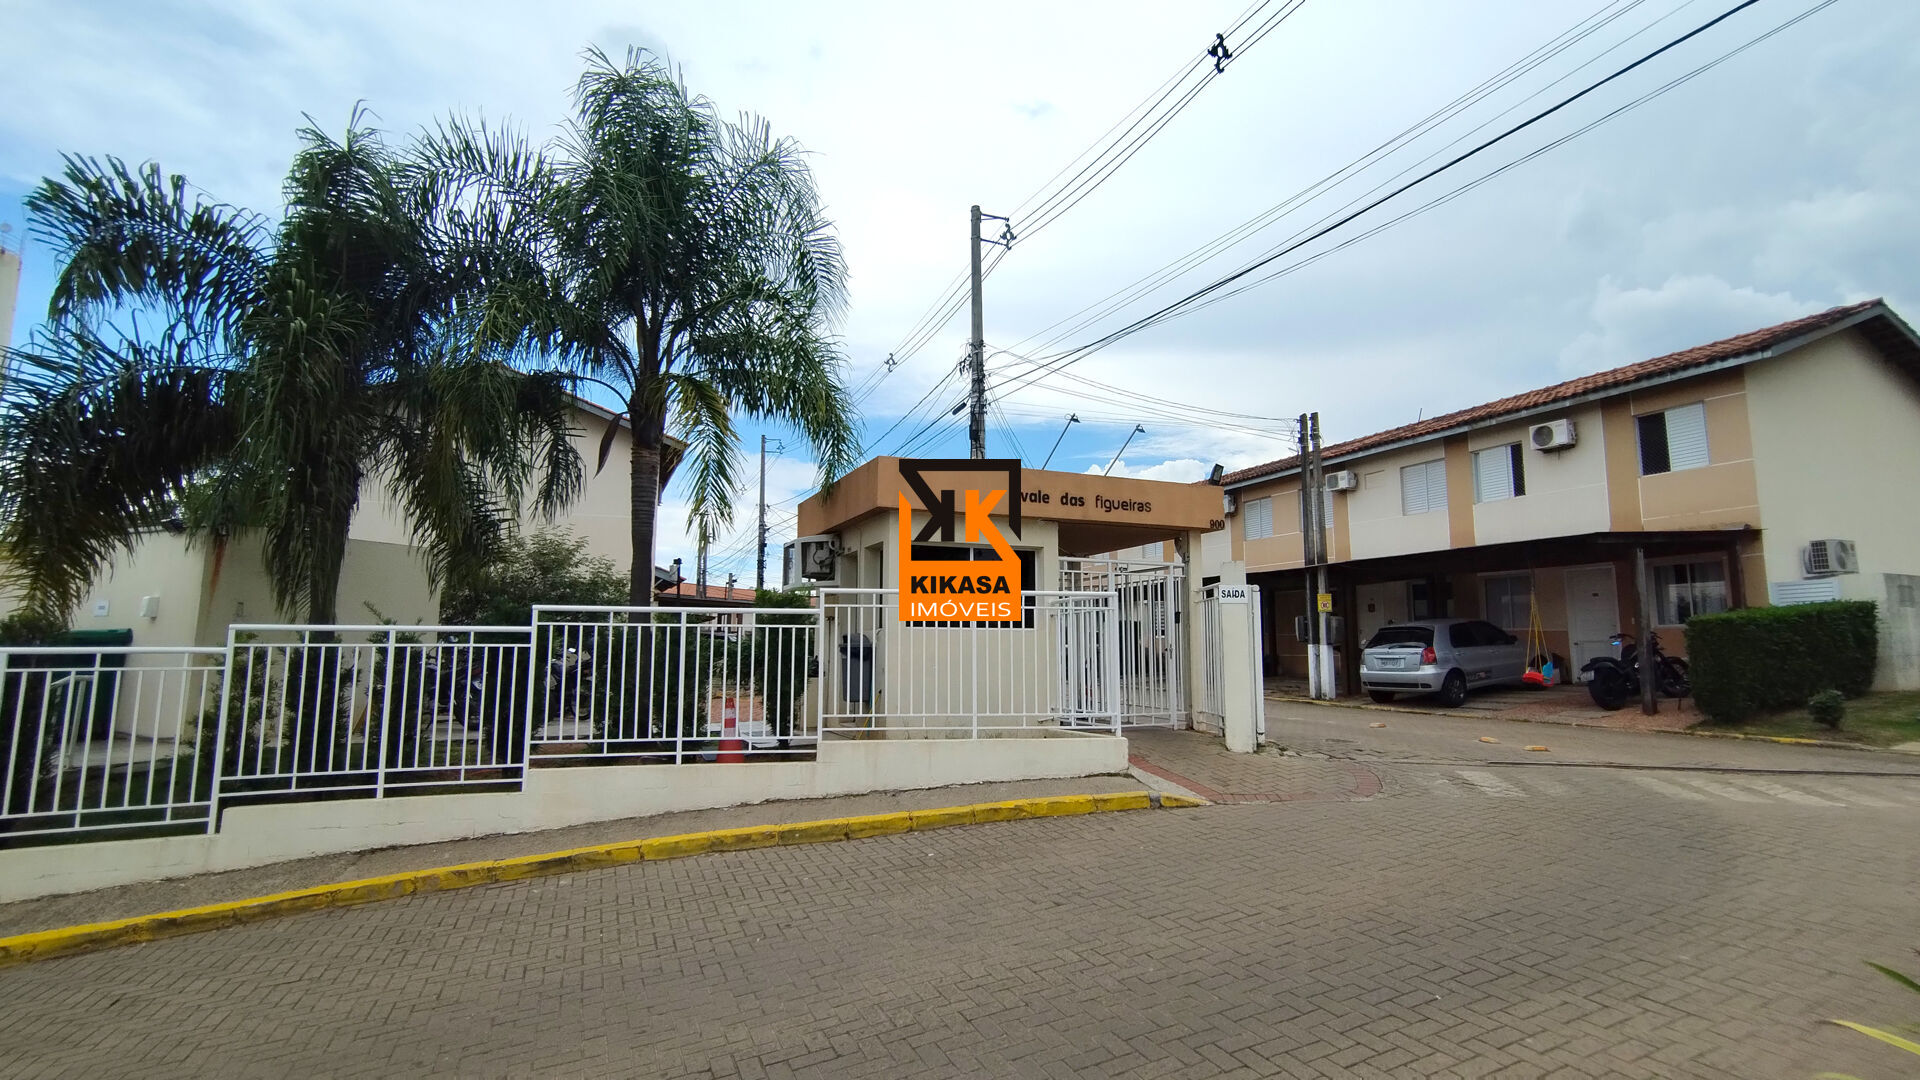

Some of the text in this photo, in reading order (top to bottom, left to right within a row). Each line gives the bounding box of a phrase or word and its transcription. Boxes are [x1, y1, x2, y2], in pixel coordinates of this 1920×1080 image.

[1020, 490, 1152, 513] vale das figueiras
[1209, 519, 1226, 530] 900
[1221, 587, 1246, 599] SAÍDA
